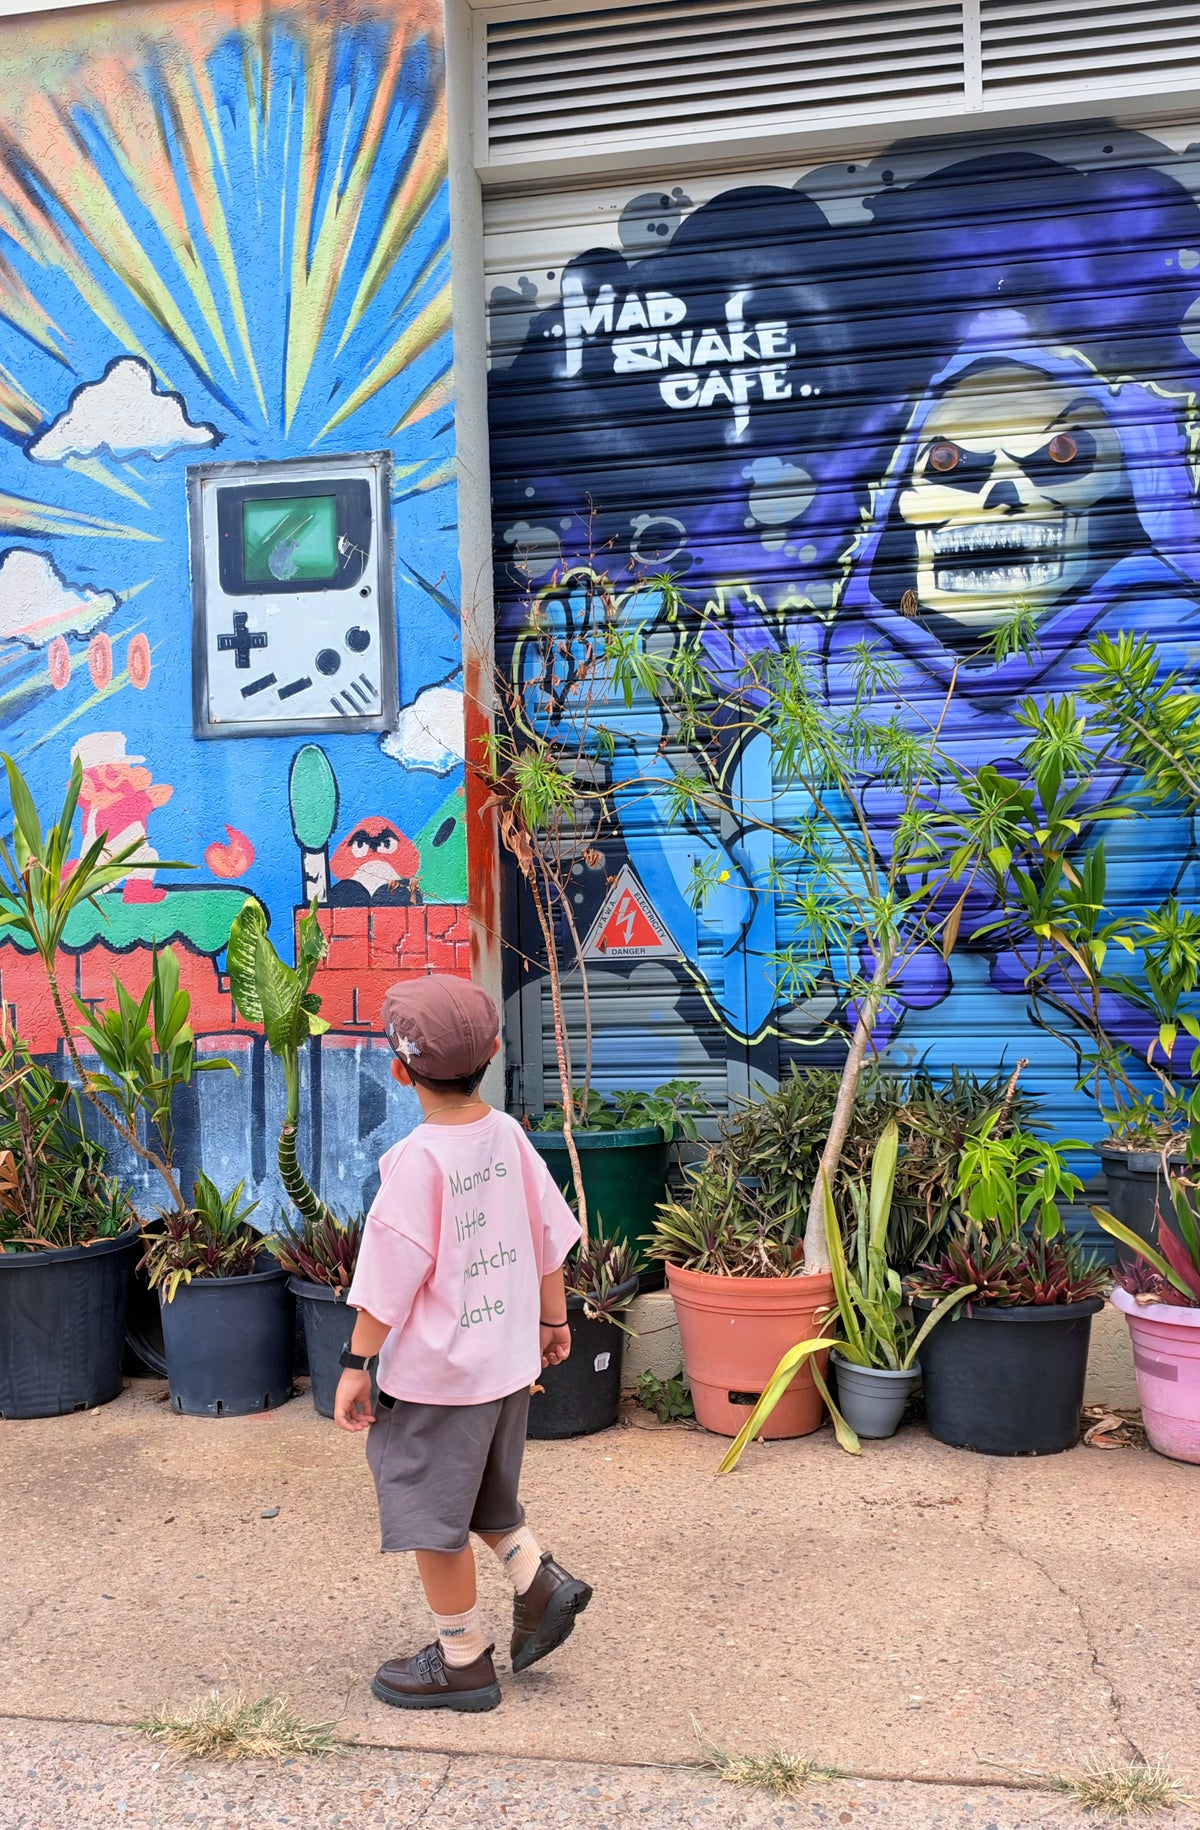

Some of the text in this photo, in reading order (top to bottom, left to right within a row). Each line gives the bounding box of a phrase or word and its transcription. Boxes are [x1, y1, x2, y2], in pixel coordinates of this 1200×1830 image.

[612, 284, 796, 374] SNAKE
[634, 892, 666, 938] ELECTRICITY
[449, 1157, 507, 1198] Mama's
[455, 1207, 487, 1243] little
[463, 1241, 517, 1285] matcha
[460, 1295, 505, 1329] date
